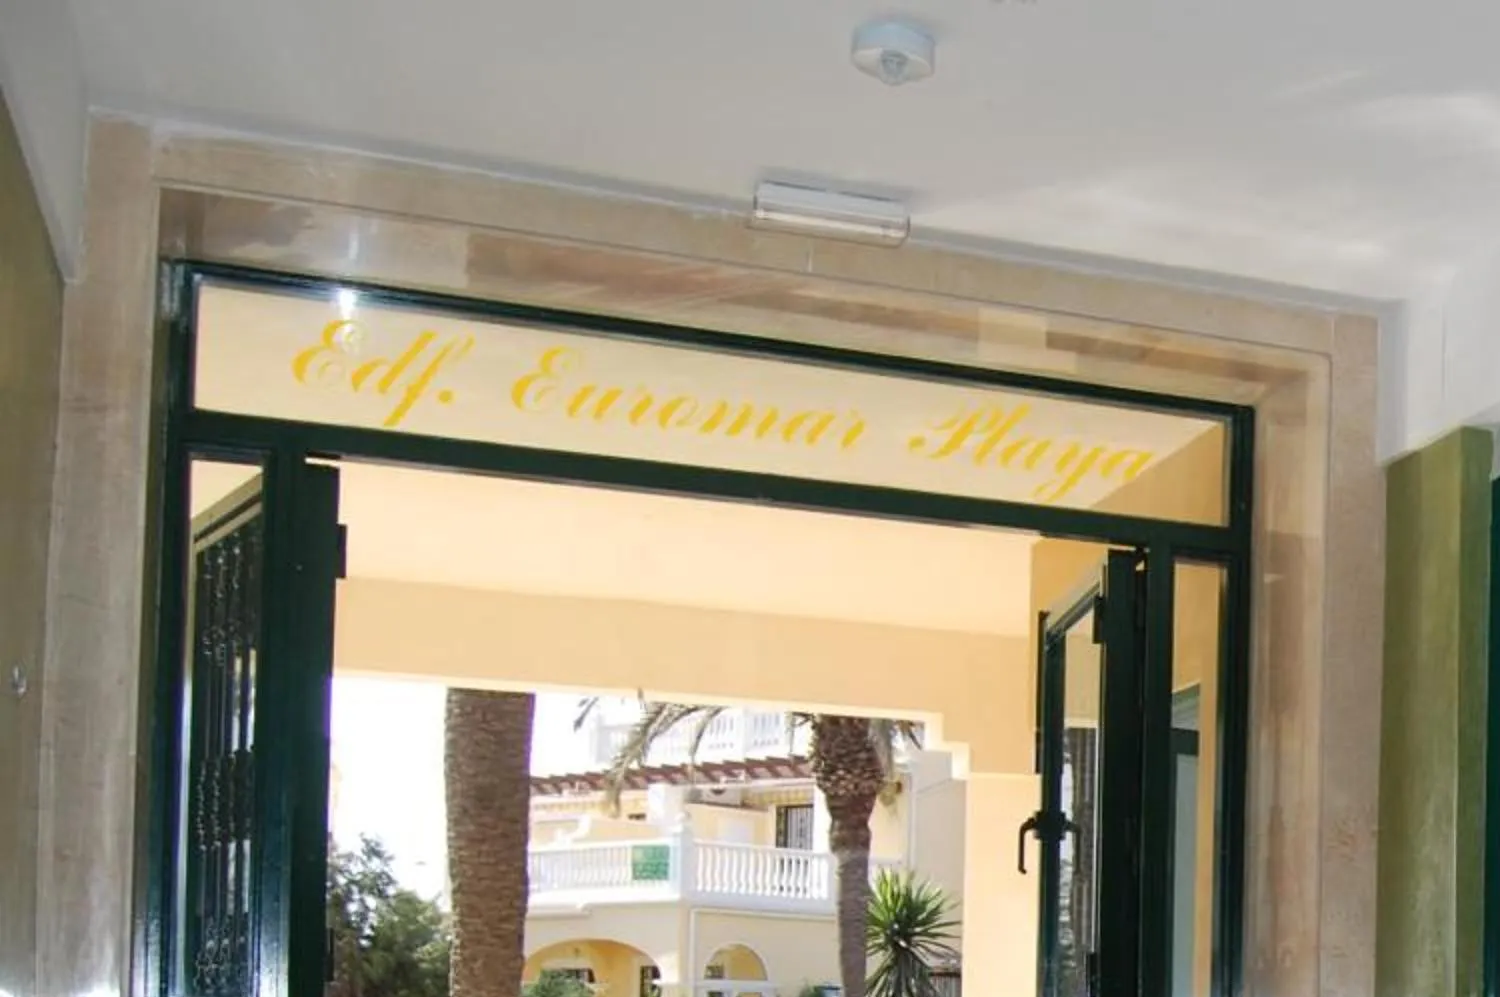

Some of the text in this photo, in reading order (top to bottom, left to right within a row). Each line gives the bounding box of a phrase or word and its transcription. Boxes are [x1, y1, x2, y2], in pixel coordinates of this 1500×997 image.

[290, 318, 1154, 503] Edf. Euromar Playa
